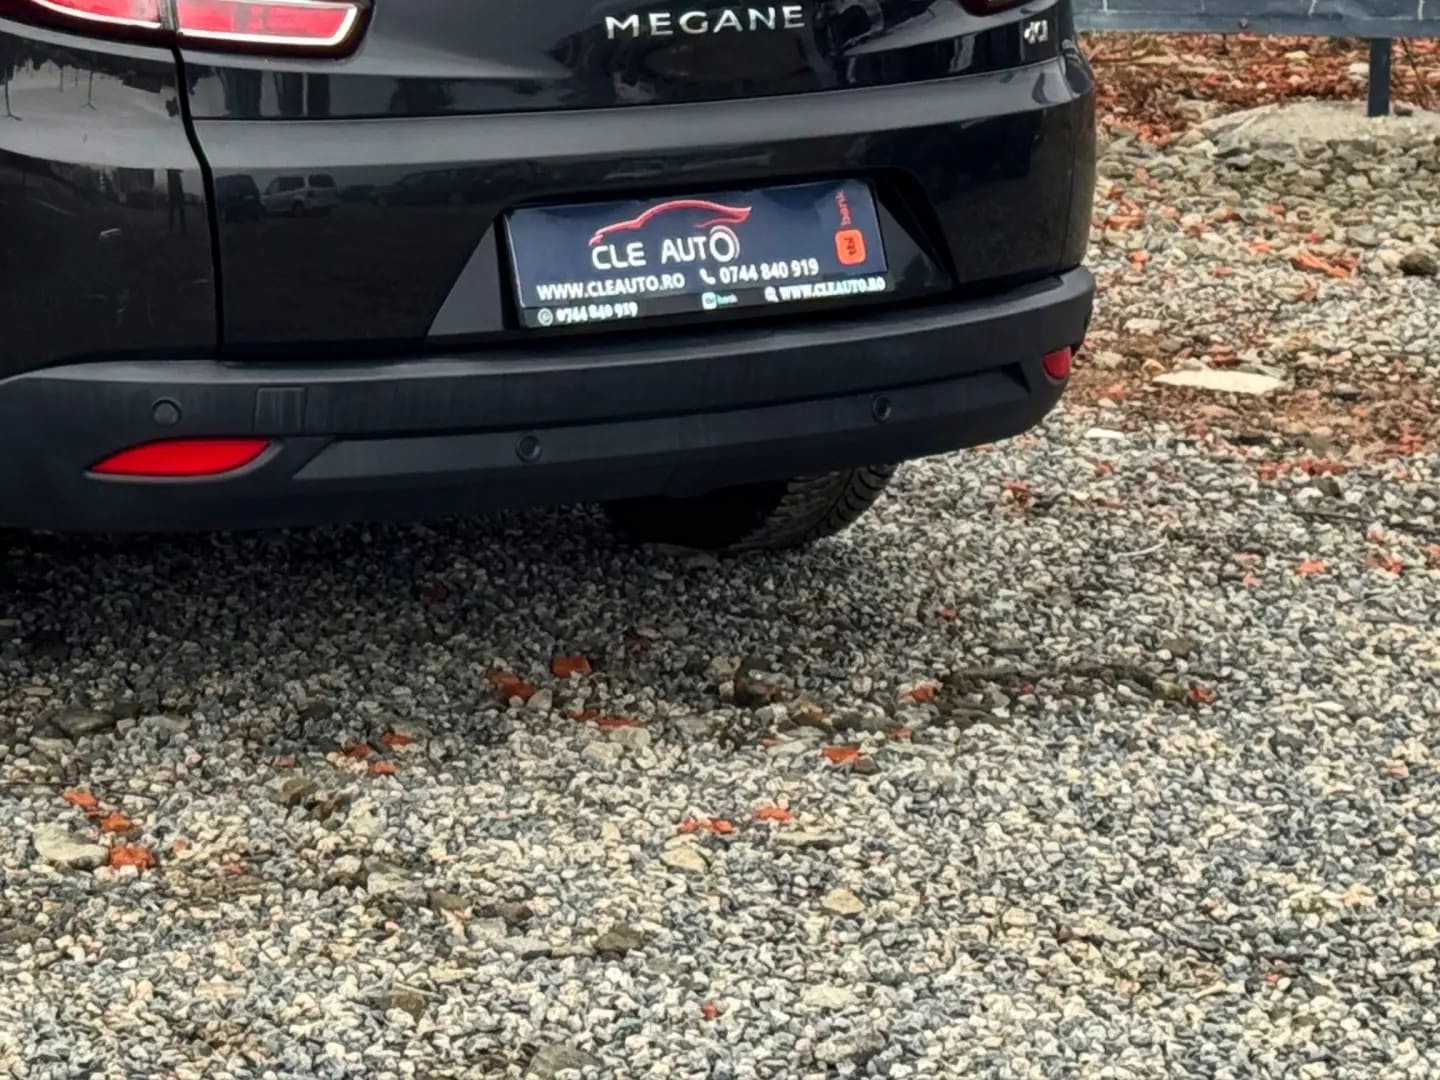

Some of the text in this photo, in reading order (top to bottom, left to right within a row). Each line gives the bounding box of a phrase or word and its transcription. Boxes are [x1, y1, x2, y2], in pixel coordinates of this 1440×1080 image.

[605, 4, 805, 40] MEGANE
[591, 225, 740, 270] CLE AUTO
[536, 272, 686, 301] WWW.CLEAUTO.RO
[719, 257, 819, 284] 0744 840 919
